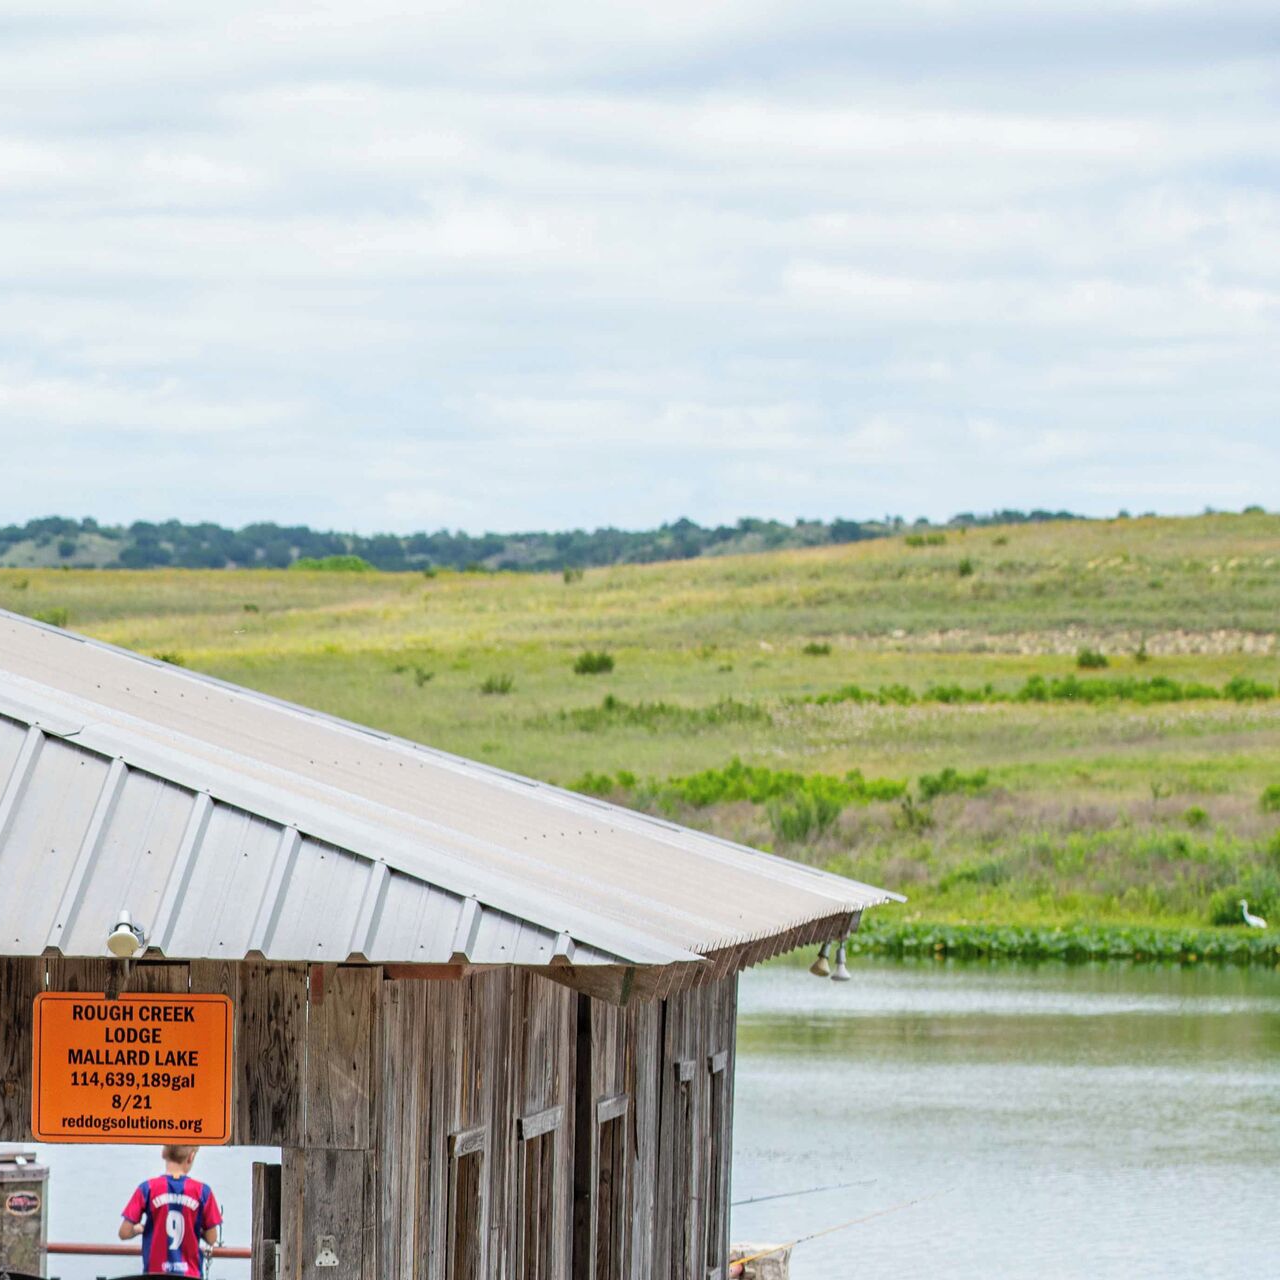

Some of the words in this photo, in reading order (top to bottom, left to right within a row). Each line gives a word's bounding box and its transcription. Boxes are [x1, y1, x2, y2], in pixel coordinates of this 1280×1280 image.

[72, 1005, 134, 1021] ROUGH
[138, 1006, 195, 1022] CREEK
[104, 1027, 162, 1044] LODGE
[67, 1049, 150, 1065] MALLARD
[155, 1051, 199, 1066] LAKE
[71, 1071, 195, 1091] 114,639,189gal
[111, 1094, 152, 1112] 8/21
[62, 1115, 203, 1133] reddogsolutions.org
[166, 1210, 185, 1250] 9
